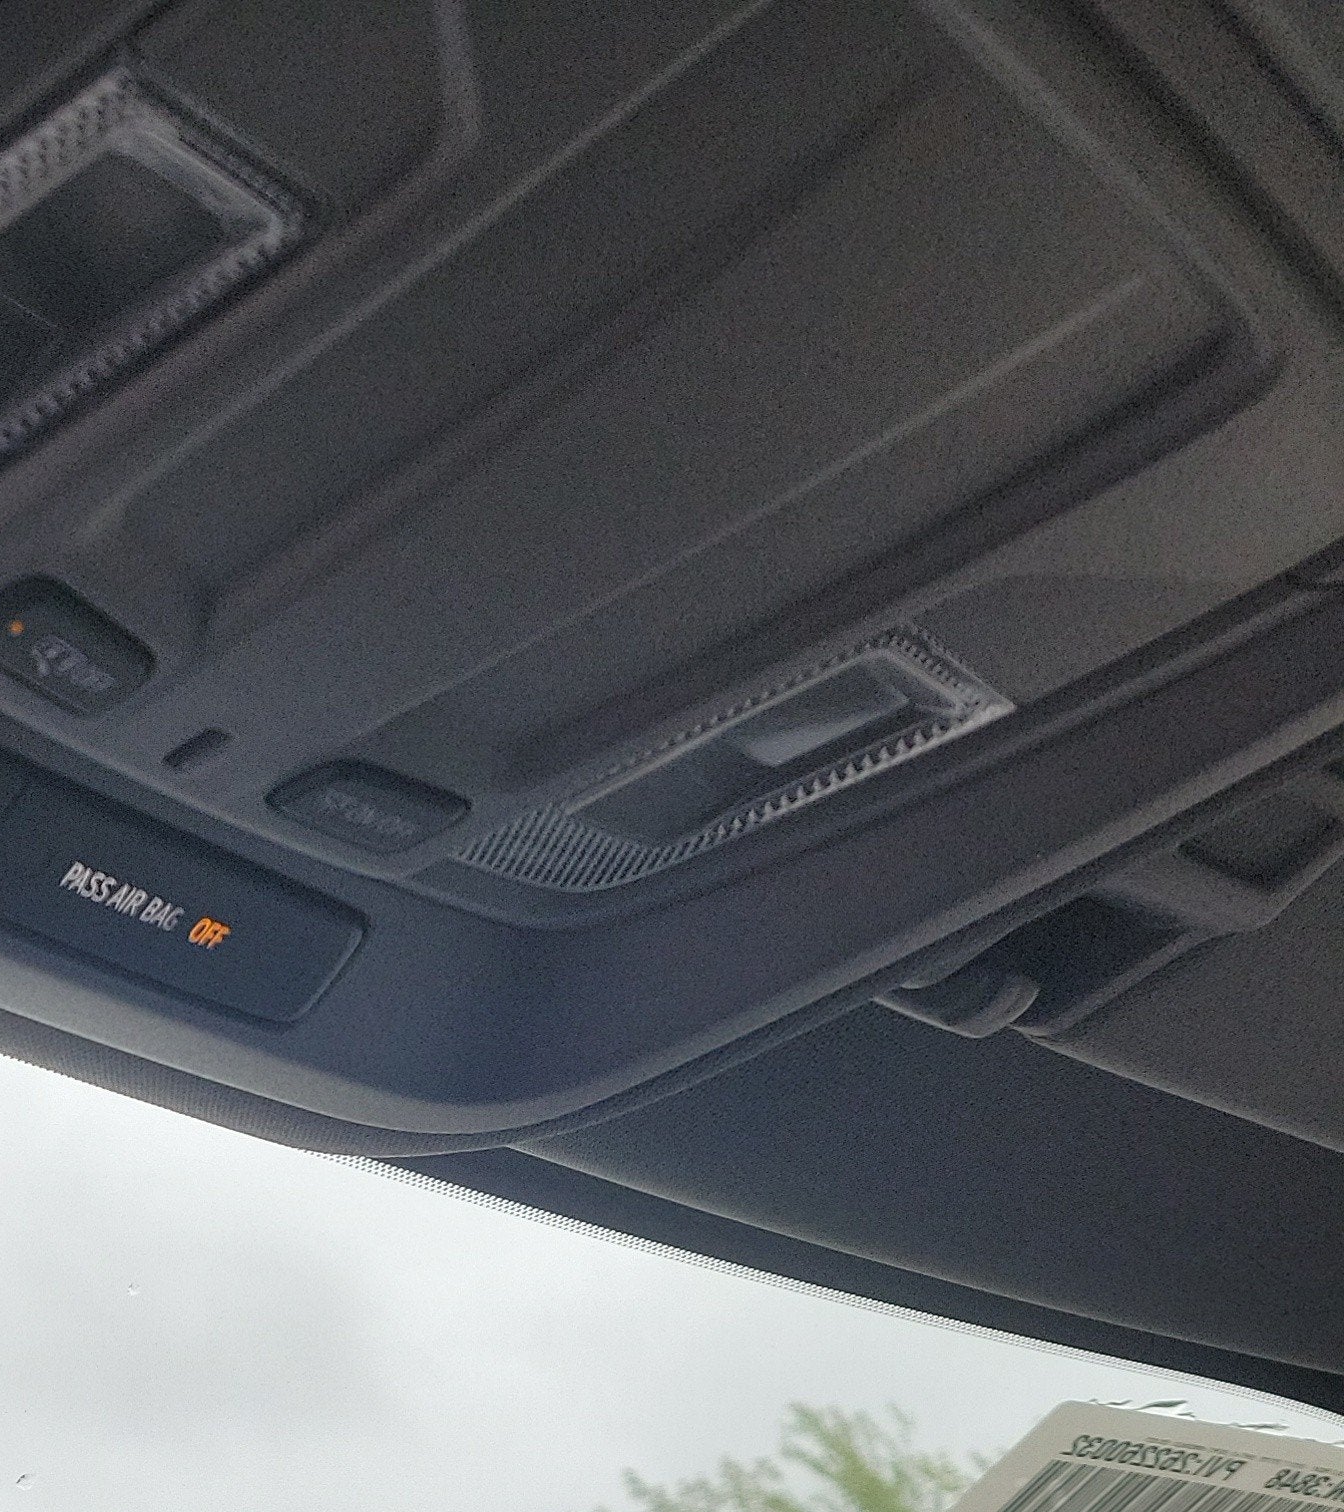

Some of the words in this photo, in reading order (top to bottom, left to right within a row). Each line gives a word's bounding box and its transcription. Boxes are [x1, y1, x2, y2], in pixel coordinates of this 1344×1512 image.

[59, 861, 116, 902] PASS
[105, 883, 148, 917] AIR
[140, 896, 185, 931] BAG
[188, 917, 231, 949] OFF
